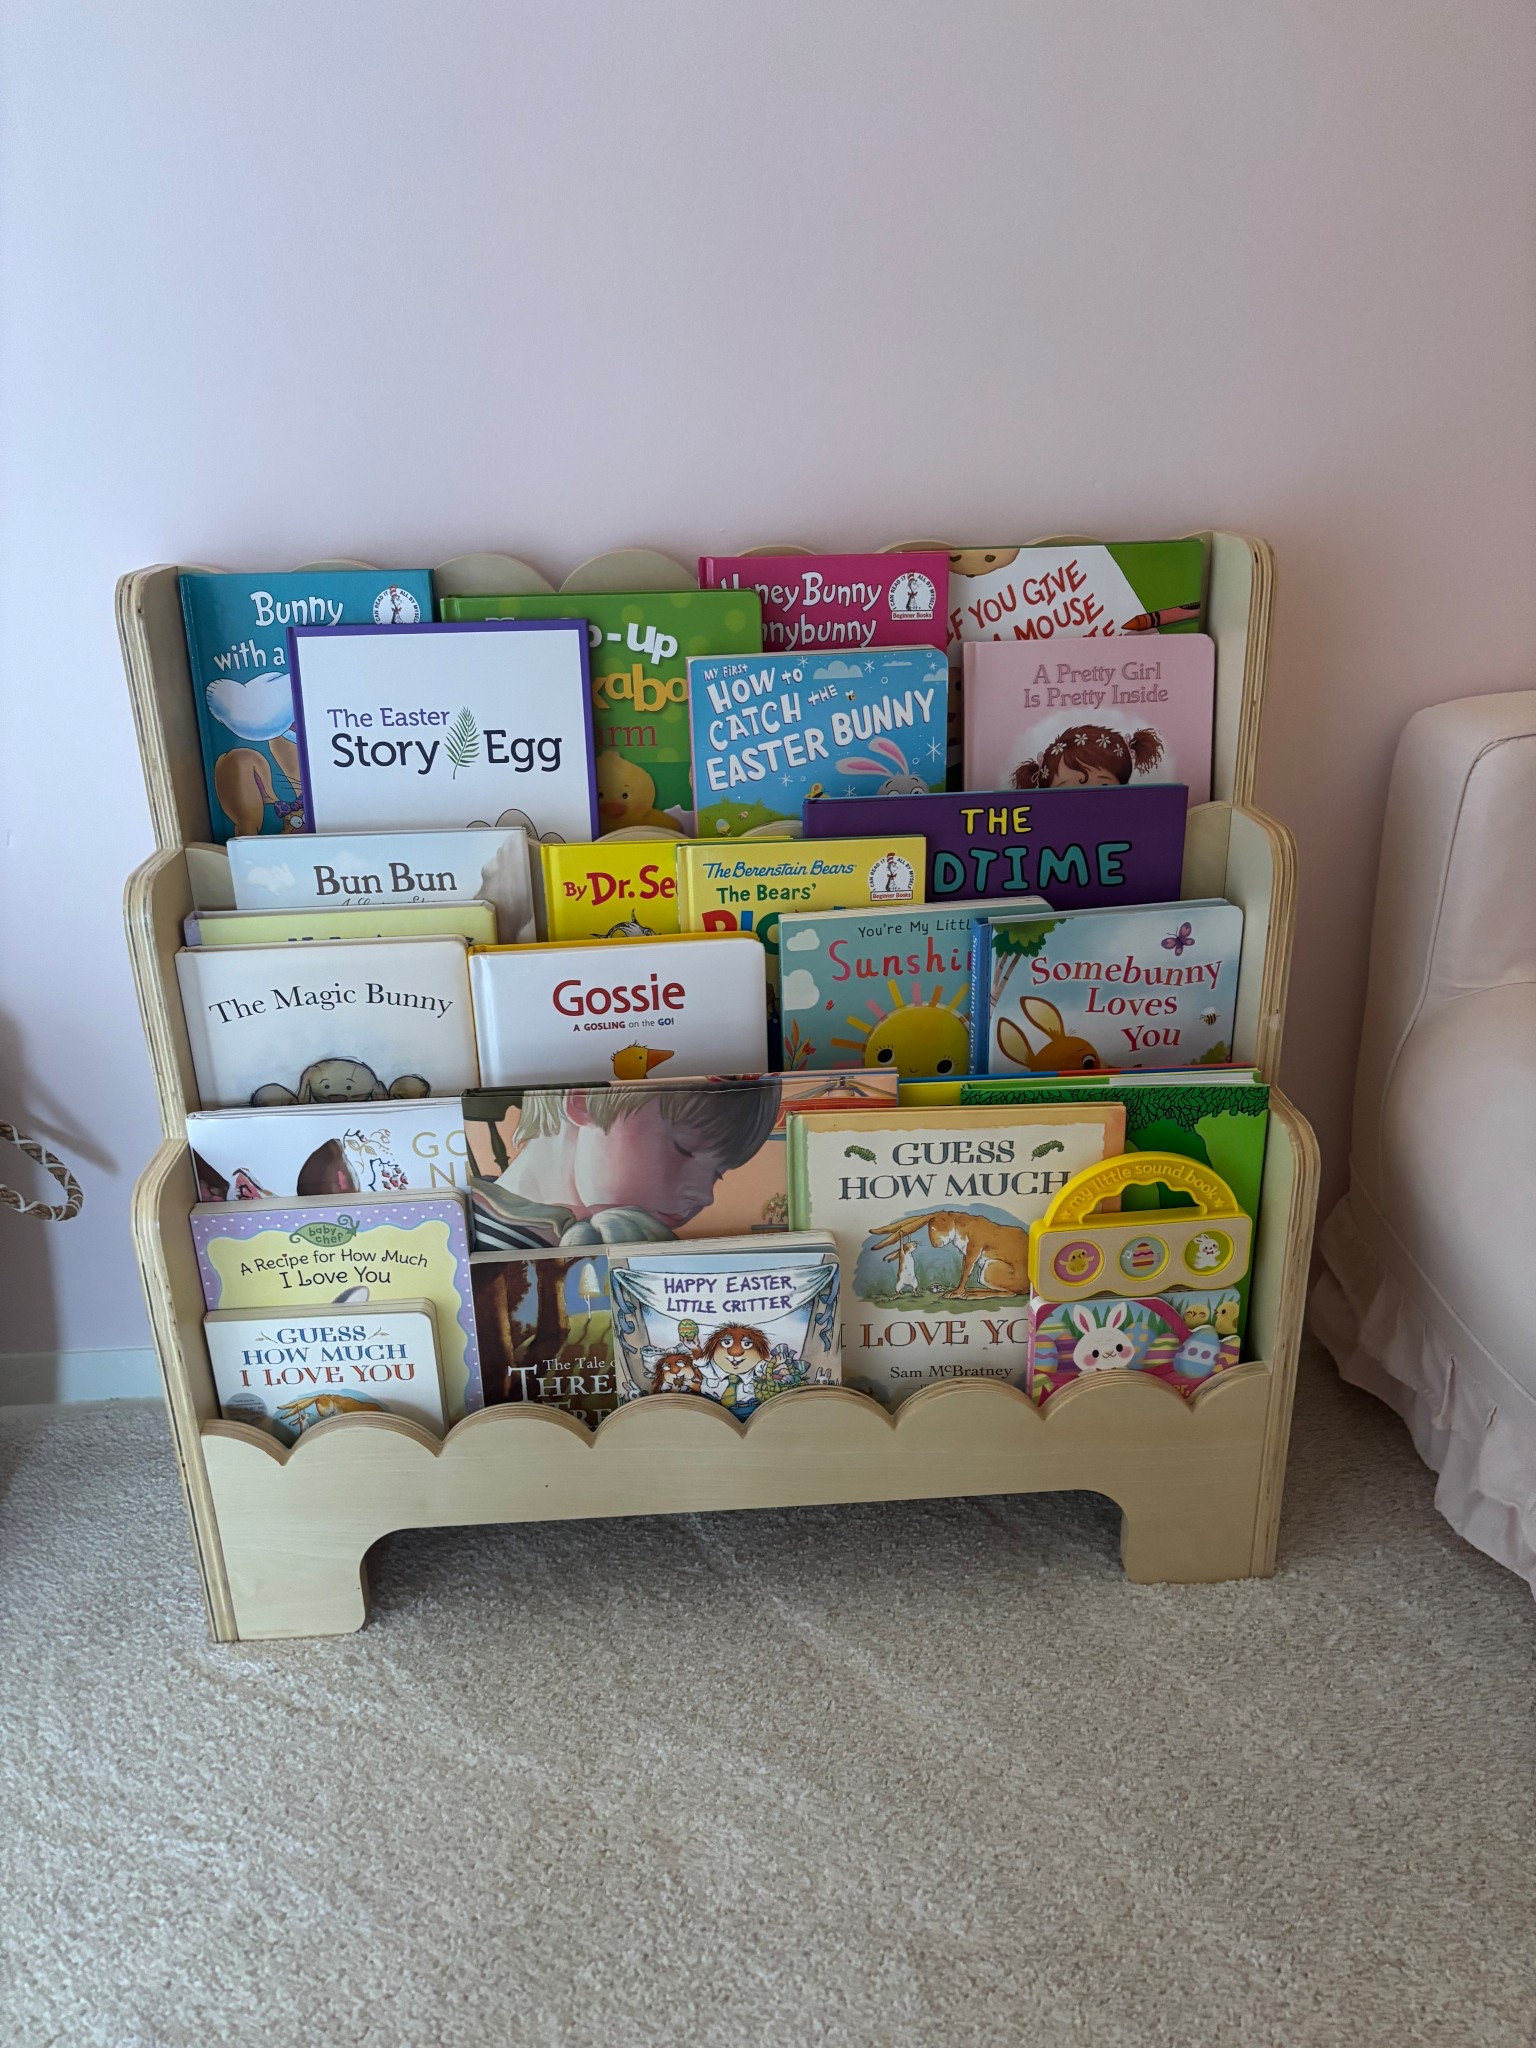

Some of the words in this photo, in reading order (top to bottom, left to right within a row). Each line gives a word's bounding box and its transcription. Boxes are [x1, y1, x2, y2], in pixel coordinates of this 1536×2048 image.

[801, 571, 882, 612] Bunny
[968, 584, 1017, 629] YOU
[1023, 559, 1087, 606] GIVE
[249, 591, 343, 627] Bunny
[1013, 593, 1105, 640] MOUSE
[213, 638, 267, 672] with
[272, 647, 286, 666] a
[703, 668, 719, 682] MY
[1033, 665, 1051, 685] A
[1056, 664, 1116, 686] Pretty
[1121, 661, 1162, 681] Girl
[706, 667, 776, 715] HOW
[1023, 688, 1041, 709] Is
[1046, 686, 1106, 710] Pretty
[1111, 684, 1169, 705] Inside
[326, 707, 374, 729] The
[380, 707, 451, 727] Easter
[709, 692, 802, 751] CATCH
[331, 732, 440, 776] Story
[483, 729, 563, 774] Egg
[706, 728, 830, 791] EASTER
[830, 688, 935, 747] BUNNY
[960, 805, 1033, 836] THE
[313, 865, 383, 896] Bun
[389, 862, 458, 894] Bun
[703, 861, 732, 879] The
[732, 861, 808, 878] Berenstain
[810, 860, 855, 876] Bears
[563, 881, 588, 902] By
[586, 872, 635, 907] Dr.
[716, 885, 751, 904] The
[857, 923, 903, 938] You're
[910, 920, 929, 936] My
[1031, 954, 1223, 990] Somebunny
[208, 998, 267, 1025] The
[270, 982, 357, 1011] Magic
[364, 983, 454, 1019] Bunny
[552, 973, 686, 1017] Gossie
[1085, 987, 1179, 1017] Loves
[573, 1022, 581, 1032] A
[583, 1020, 626, 1032] GOSLING
[628, 1021, 640, 1029] on
[641, 1018, 656, 1028] the
[657, 1017, 675, 1027] GO!
[1121, 1025, 1182, 1056] You
[892, 1139, 1016, 1168] GUESS
[839, 1172, 939, 1201] HOW
[944, 1169, 1070, 1200] MUCH
[1070, 1188, 1092, 1209] my
[1092, 1167, 1133, 1192] little
[1135, 1163, 1185, 1179] sound
[1185, 1169, 1219, 1201] book
[308, 1224, 338, 1244] baby
[314, 1231, 344, 1245] chef
[239, 1262, 253, 1276] A
[254, 1252, 310, 1273] Recipe
[312, 1249, 336, 1264] for
[341, 1248, 377, 1263] How
[381, 1249, 428, 1268] Much
[279, 1271, 292, 1290] I
[297, 1269, 348, 1287] Love
[353, 1266, 392, 1284] You
[663, 1276, 719, 1295] HAPPY
[725, 1274, 798, 1294] EASTER,
[666, 1296, 718, 1314] LITTLE
[722, 1295, 793, 1313] CRITTER
[276, 1325, 367, 1344] GUESS
[859, 1320, 970, 1349] LOVE
[241, 1347, 311, 1366] HOW
[320, 1343, 409, 1362] MUCH
[542, 1358, 571, 1372] The
[575, 1356, 606, 1370] Tale
[239, 1368, 253, 1387] I
[263, 1366, 344, 1387] LOVE
[350, 1362, 416, 1383] YOU
[507, 1364, 617, 1404] THRE
[890, 1366, 922, 1379] Sam
[928, 1364, 1013, 1379] McBratney
